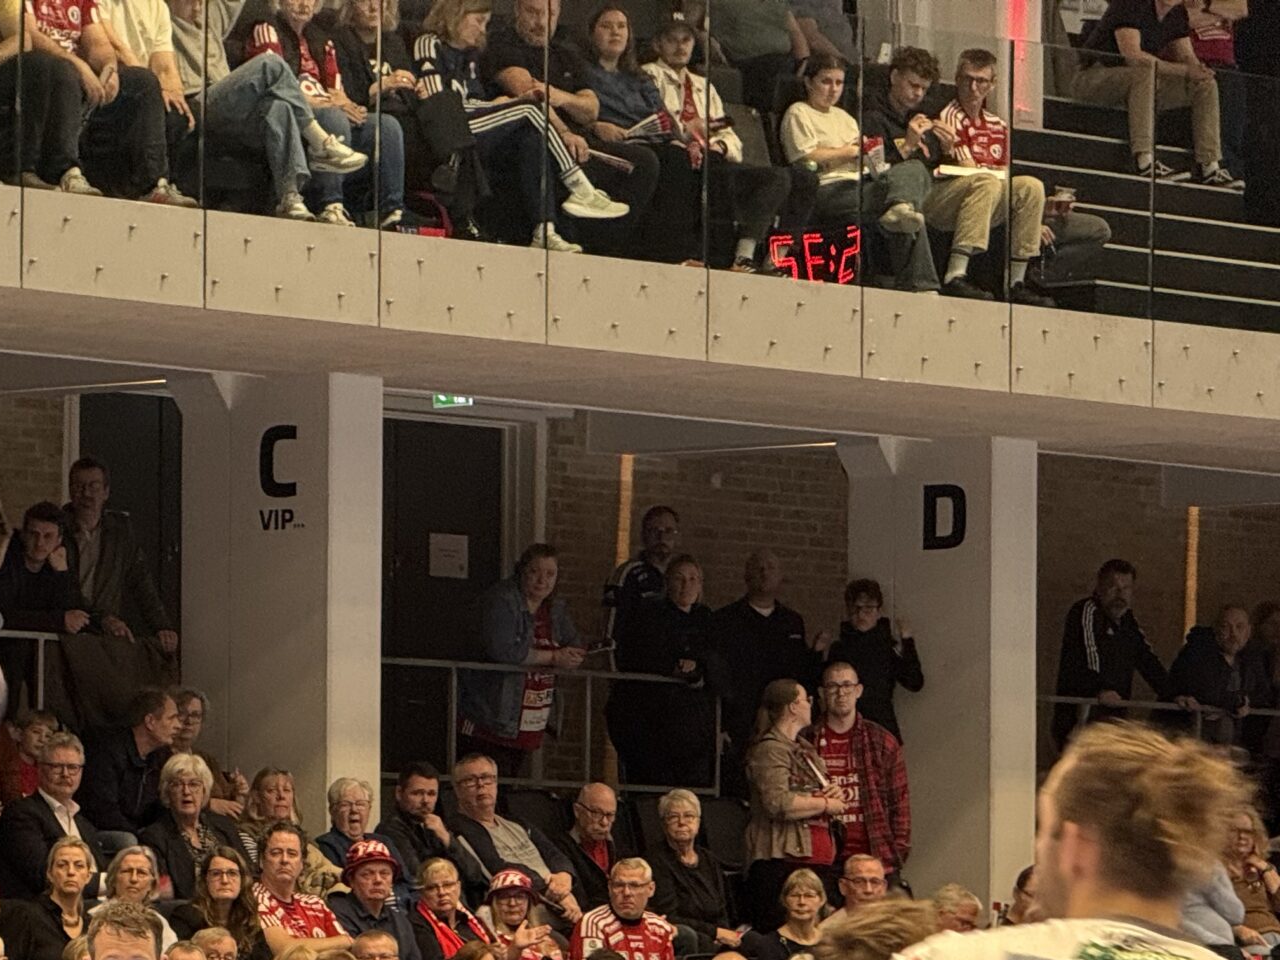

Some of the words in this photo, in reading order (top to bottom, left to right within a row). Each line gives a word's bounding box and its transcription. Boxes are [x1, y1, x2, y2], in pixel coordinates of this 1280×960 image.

[259, 424, 297, 498] C
[259, 508, 295, 531] VIP
[923, 483, 967, 550] D
